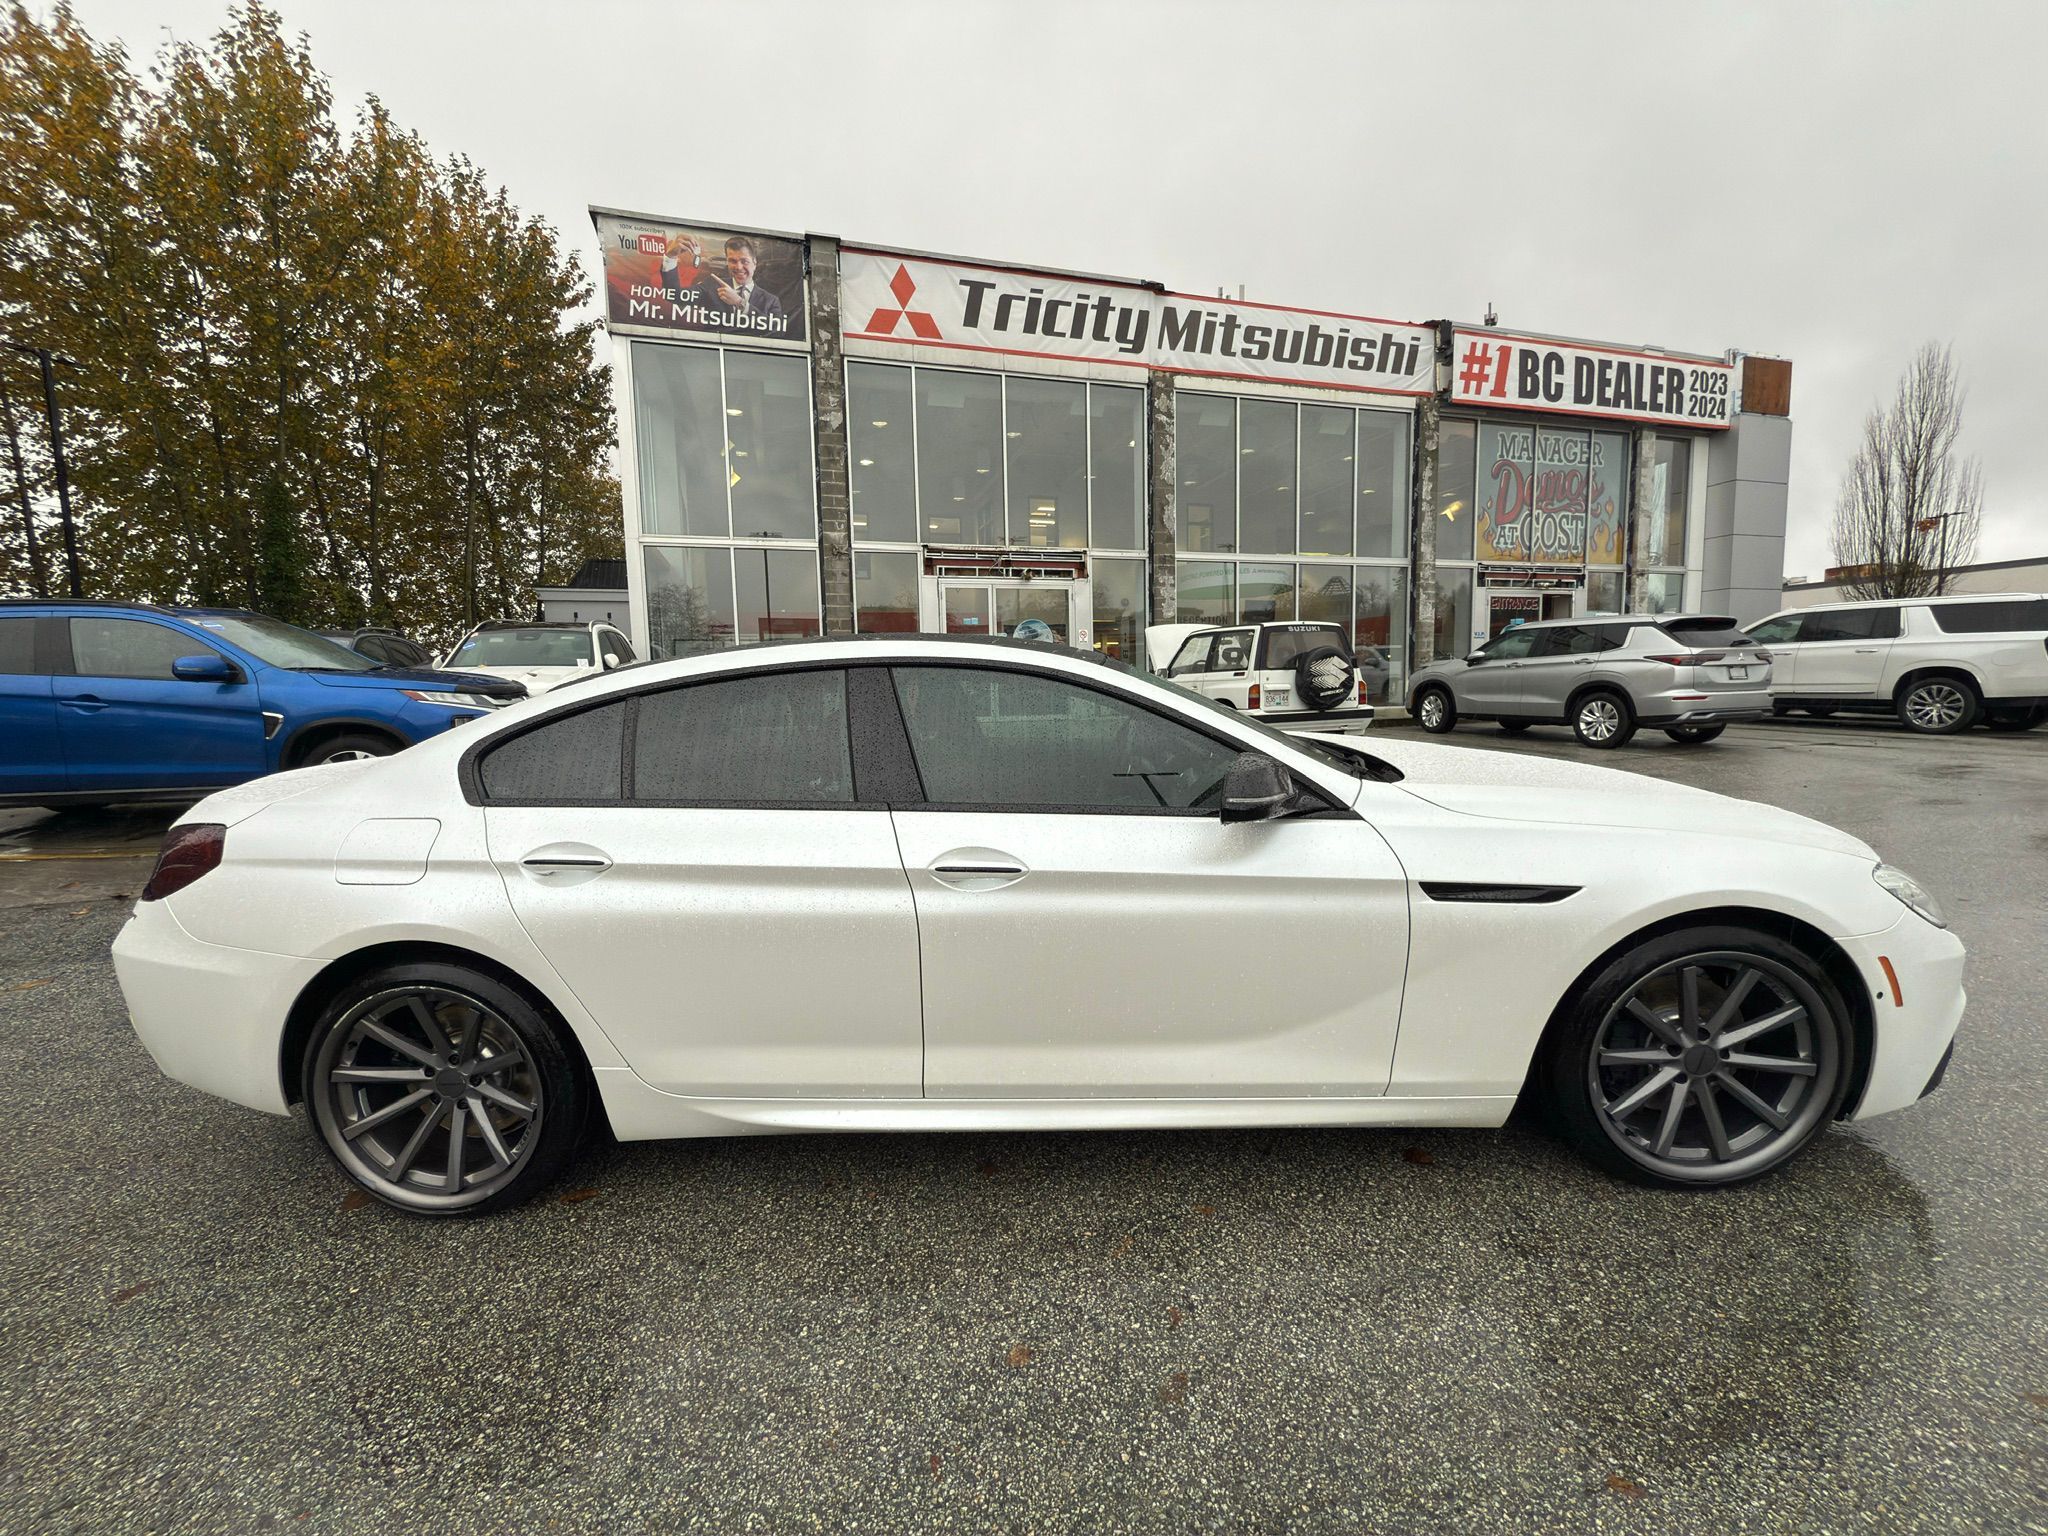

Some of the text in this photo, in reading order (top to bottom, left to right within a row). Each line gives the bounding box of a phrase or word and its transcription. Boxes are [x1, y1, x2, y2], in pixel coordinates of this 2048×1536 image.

[630, 284, 700, 303] HOME OF
[629, 300, 788, 332] Mr. Mitsubishi
[958, 279, 1421, 376] Tricity Mitsubishi
[1459, 341, 1728, 416] #1 BC DEALER 2023
[1689, 394, 1727, 421] 2024
[1498, 432, 1604, 466] MANAGER
[1494, 510, 1585, 552] AT COST
[1491, 598, 1539, 610] ENTRANCE
